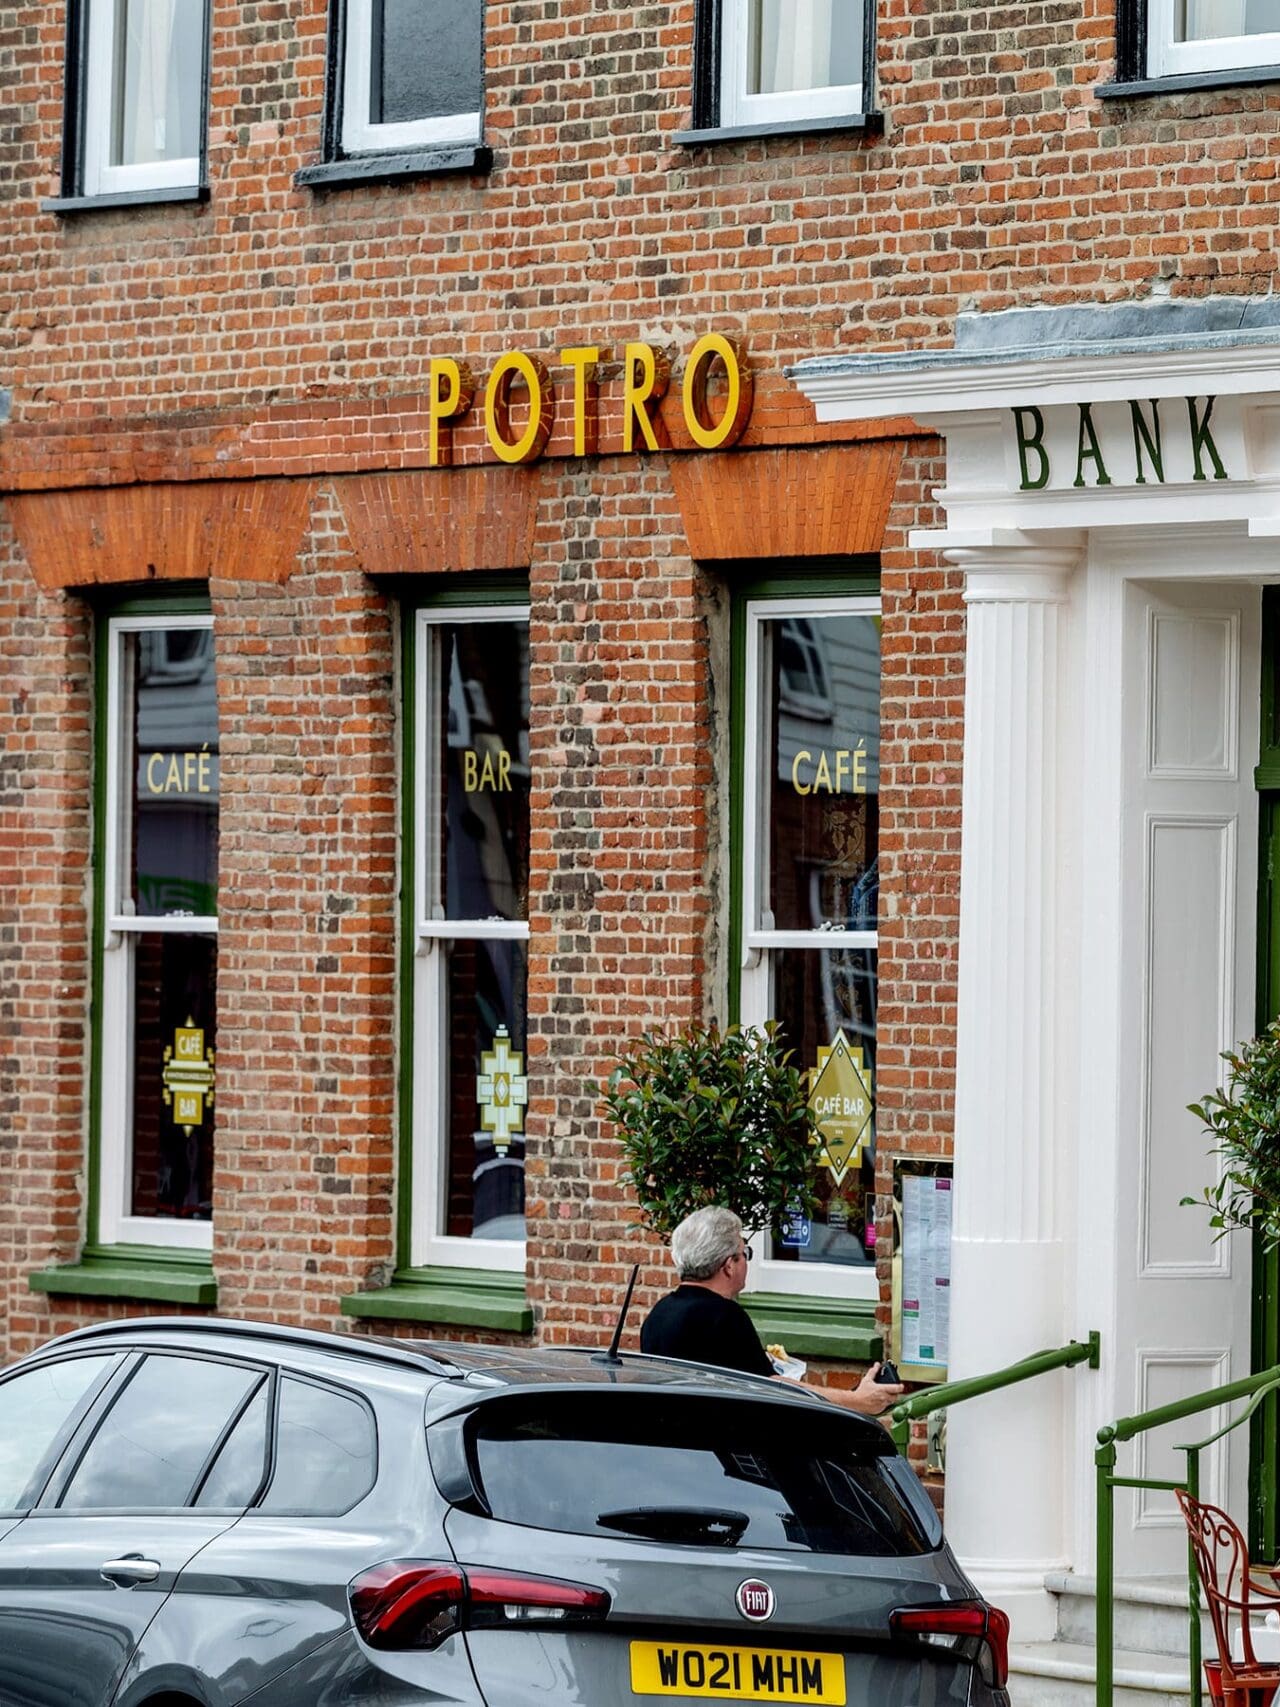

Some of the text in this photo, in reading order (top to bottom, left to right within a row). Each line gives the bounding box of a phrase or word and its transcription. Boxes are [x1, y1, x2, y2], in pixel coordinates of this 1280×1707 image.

[429, 332, 742, 466] POTRO
[1010, 395, 1229, 491] BANK
[146, 743, 211, 794] CAFÉ
[464, 751, 512, 793] BAR
[791, 738, 868, 796] CAFÉ
[814, 1093, 865, 1116] CAFÉ BAR
[745, 1590, 768, 1611] FIAT
[657, 1648, 823, 1696] WO21 MHM
